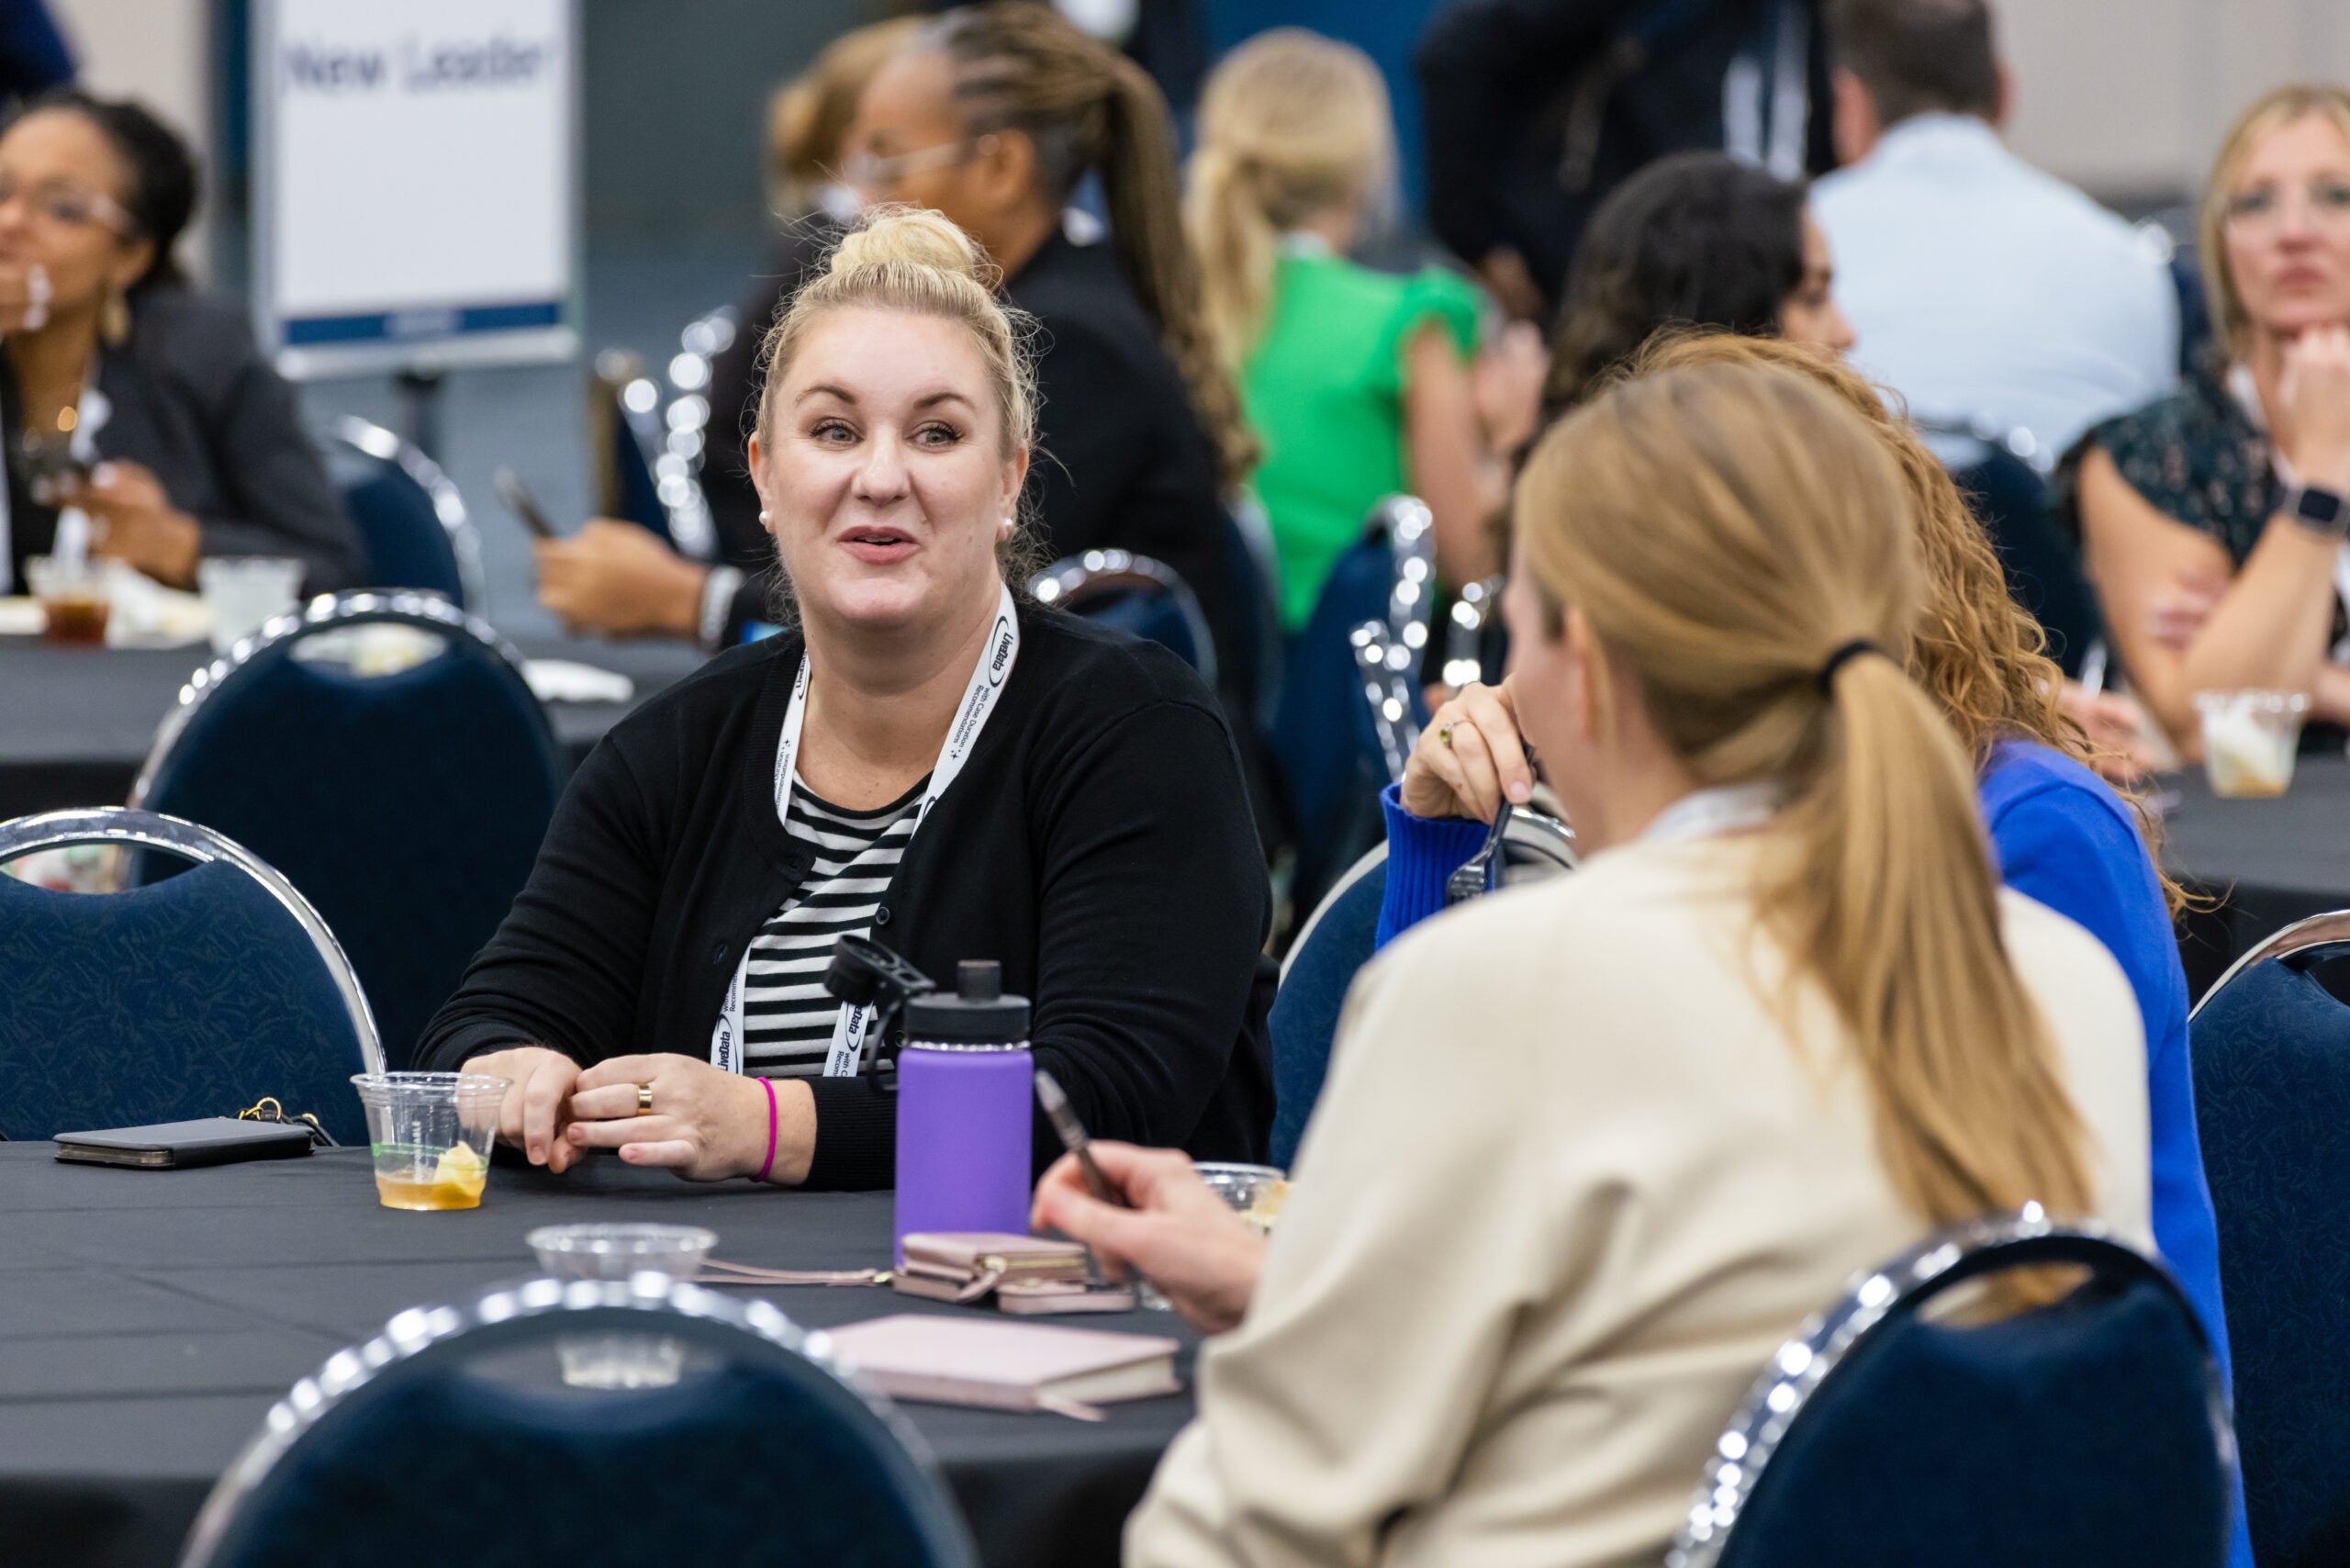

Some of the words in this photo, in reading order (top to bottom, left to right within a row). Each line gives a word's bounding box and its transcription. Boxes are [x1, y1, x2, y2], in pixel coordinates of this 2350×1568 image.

[281, 43, 386, 91] New
[992, 632, 1013, 671] LiveData
[979, 688, 990, 702] with
[953, 684, 985, 744] Recommendations
[972, 702, 985, 719] Case
[958, 719, 977, 748] Duration
[842, 1052, 851, 1069] with
